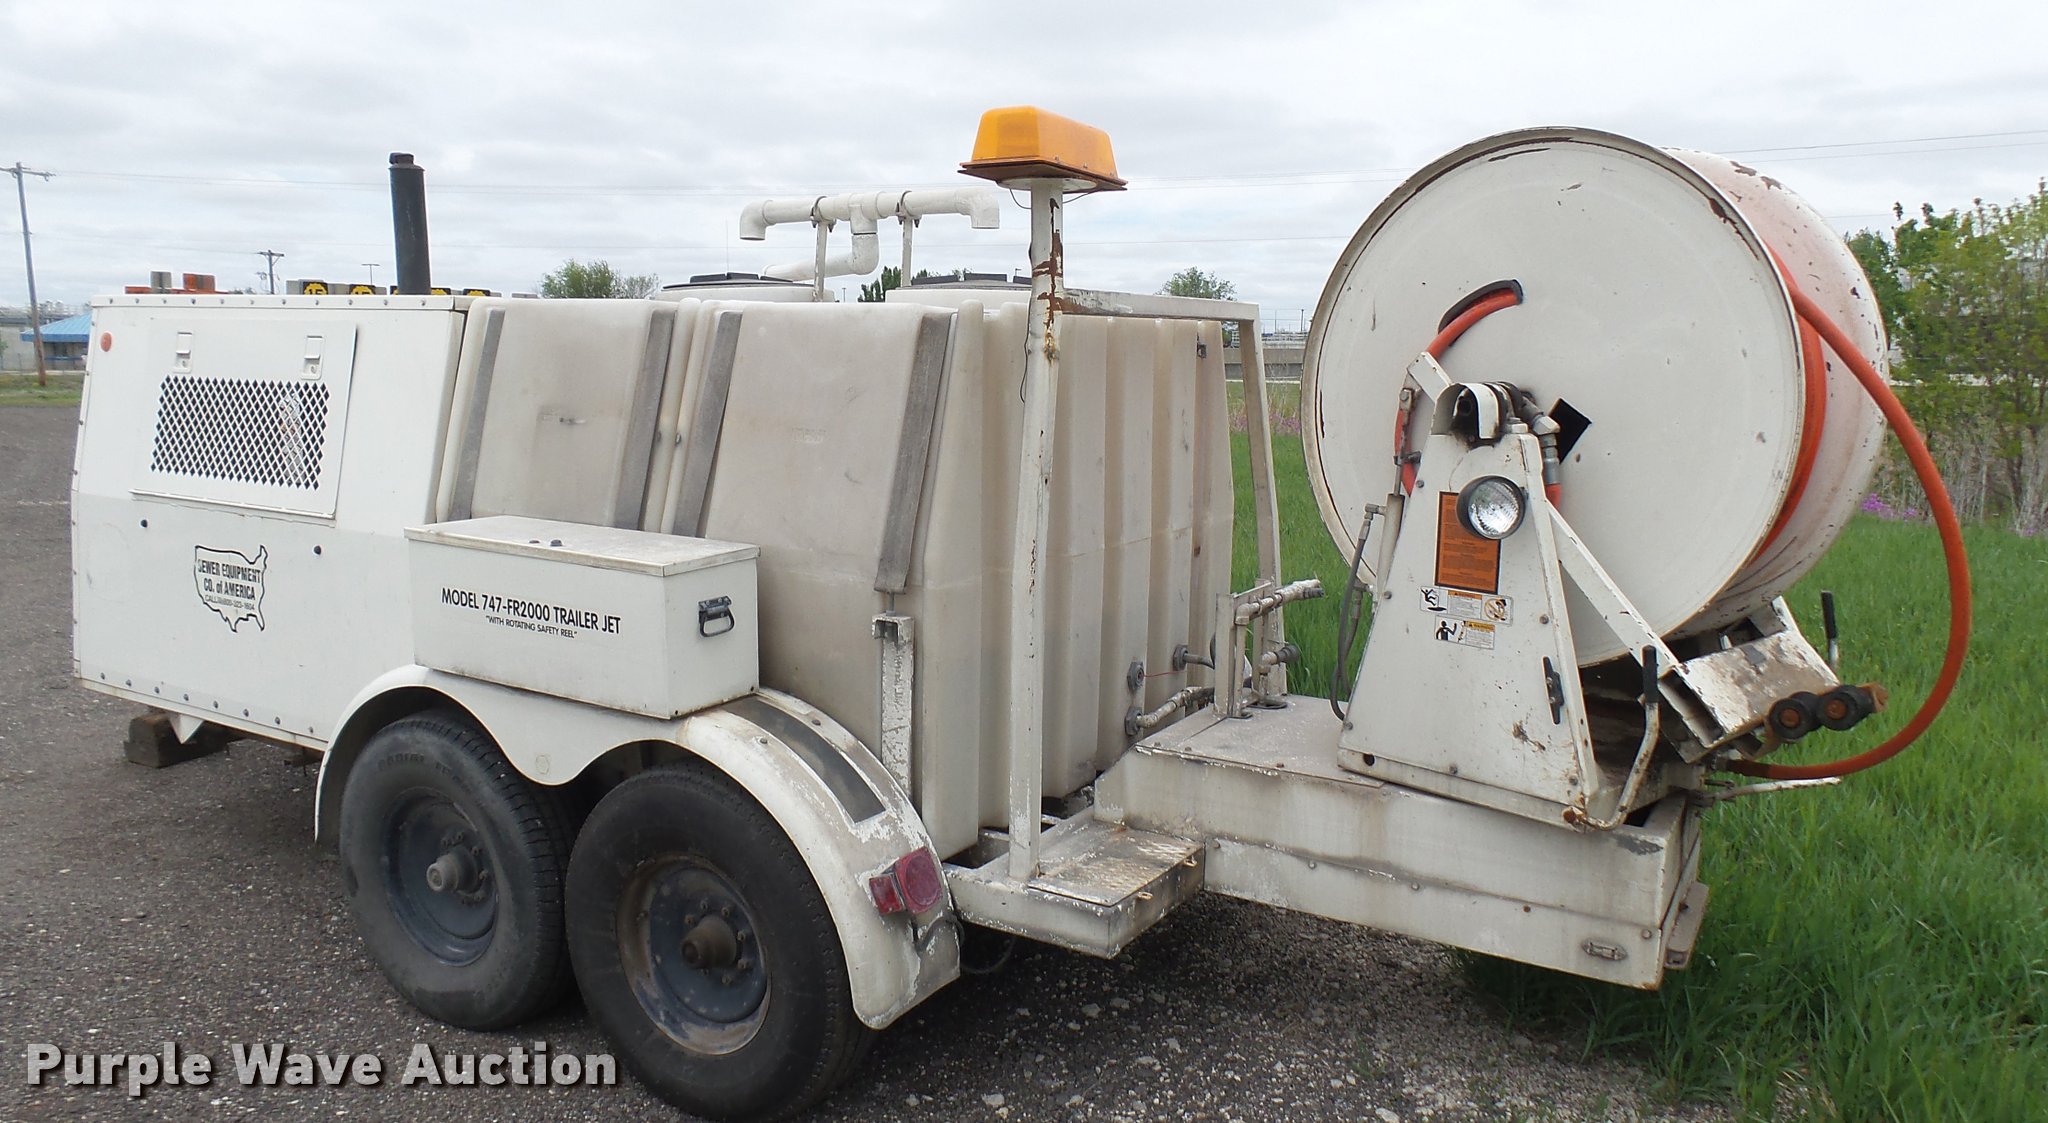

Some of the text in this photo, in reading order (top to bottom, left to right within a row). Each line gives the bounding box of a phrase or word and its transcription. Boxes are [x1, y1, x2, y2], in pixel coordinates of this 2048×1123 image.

[222, 563, 261, 583] EQUIPMENT
[203, 578, 215, 592] CO.
[224, 582, 256, 600] AMERICA
[441, 587, 621, 634] MODEL 747-FR2000 TRAILER JET
[485, 615, 578, 639] "WITH ROTATING SAFETY REEL"
